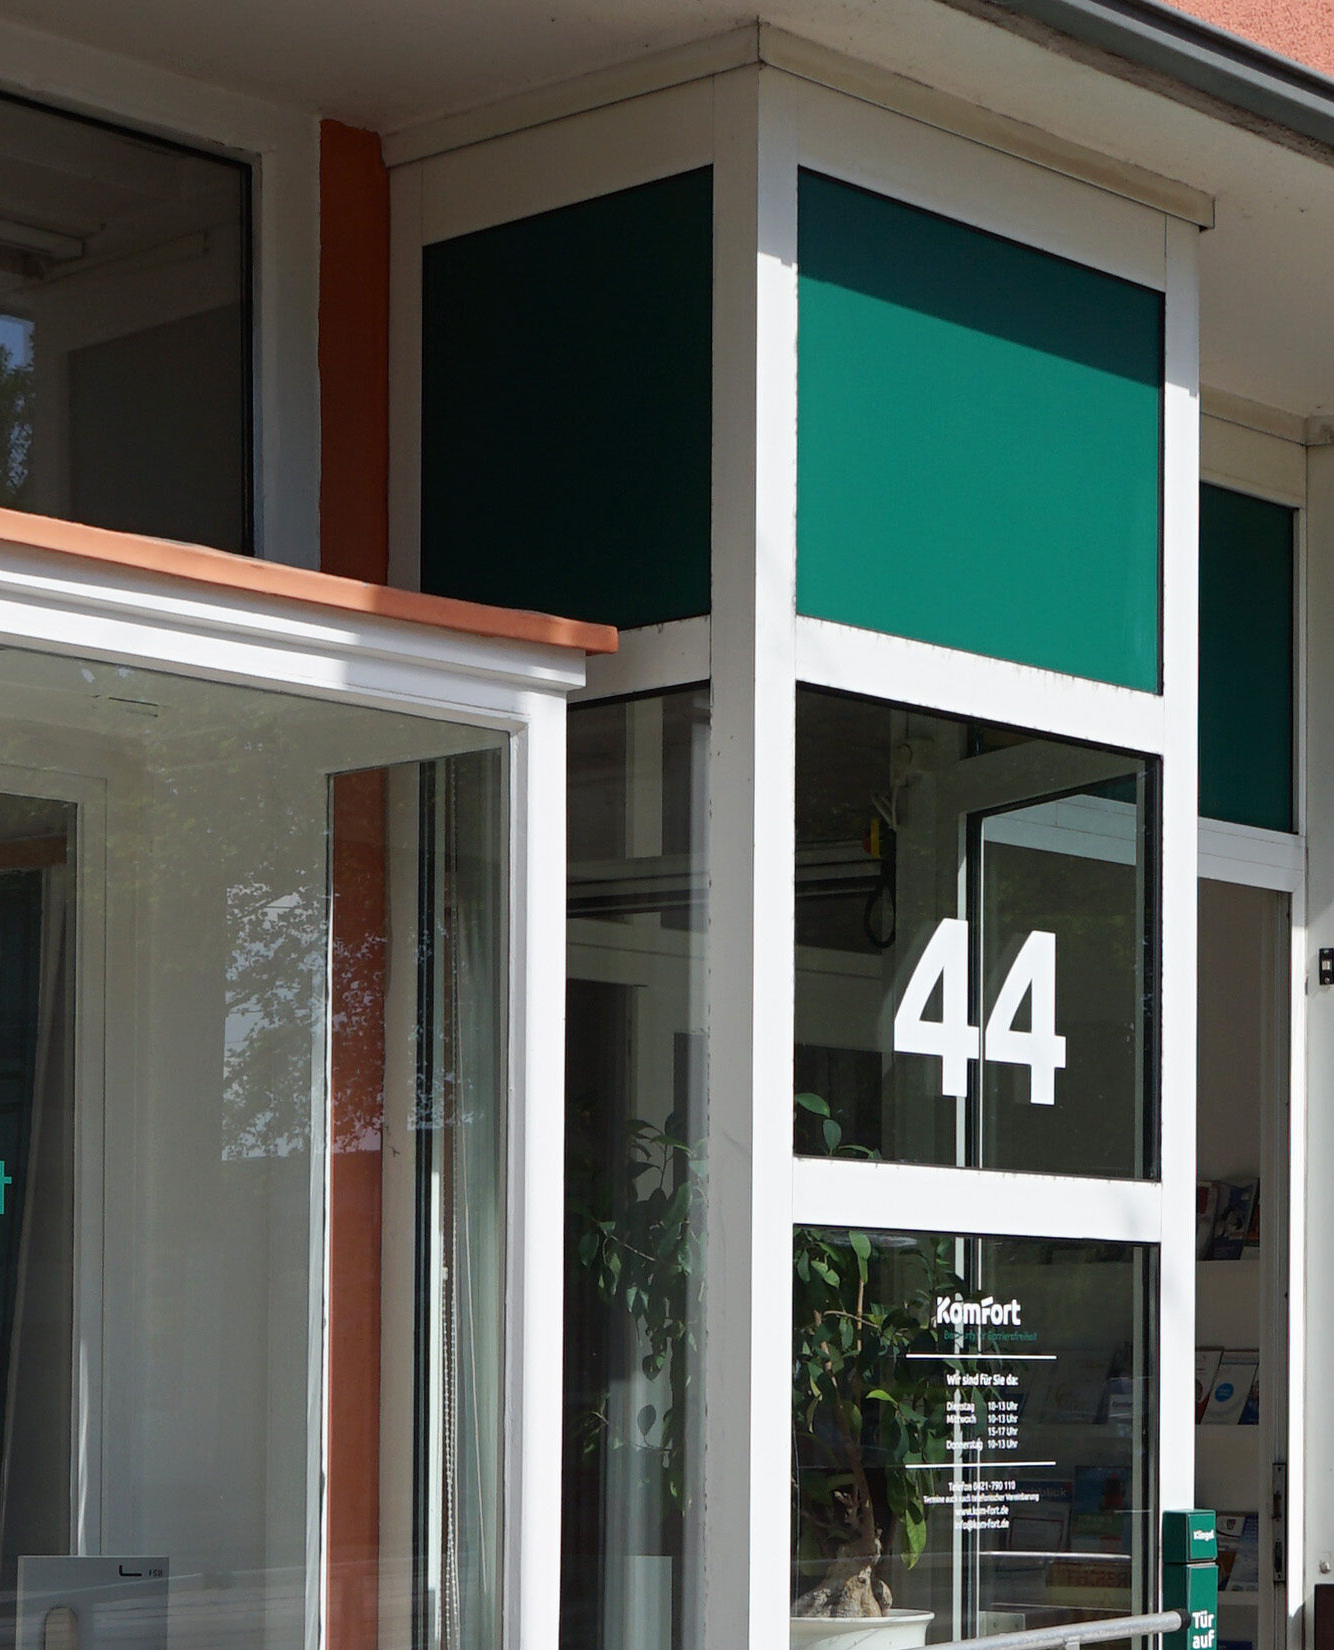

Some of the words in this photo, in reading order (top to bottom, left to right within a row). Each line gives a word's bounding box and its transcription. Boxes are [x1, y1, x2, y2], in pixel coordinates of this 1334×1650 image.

[893, 918, 1066, 1105] 44
[946, 1373, 961, 1386] Wir
[962, 1373, 979, 1386] sind
[993, 1373, 1005, 1386] Sie
[1006, 1373, 1019, 1386] da:
[1006, 1401, 1018, 1411] Uhr
[1006, 1413, 1018, 1424] Uhr
[1006, 1426, 1018, 1436] Uhr
[1006, 1439, 1018, 1449] Uhr
[1192, 1610, 1215, 1629] Tür
[1192, 1630, 1215, 1649] auf
